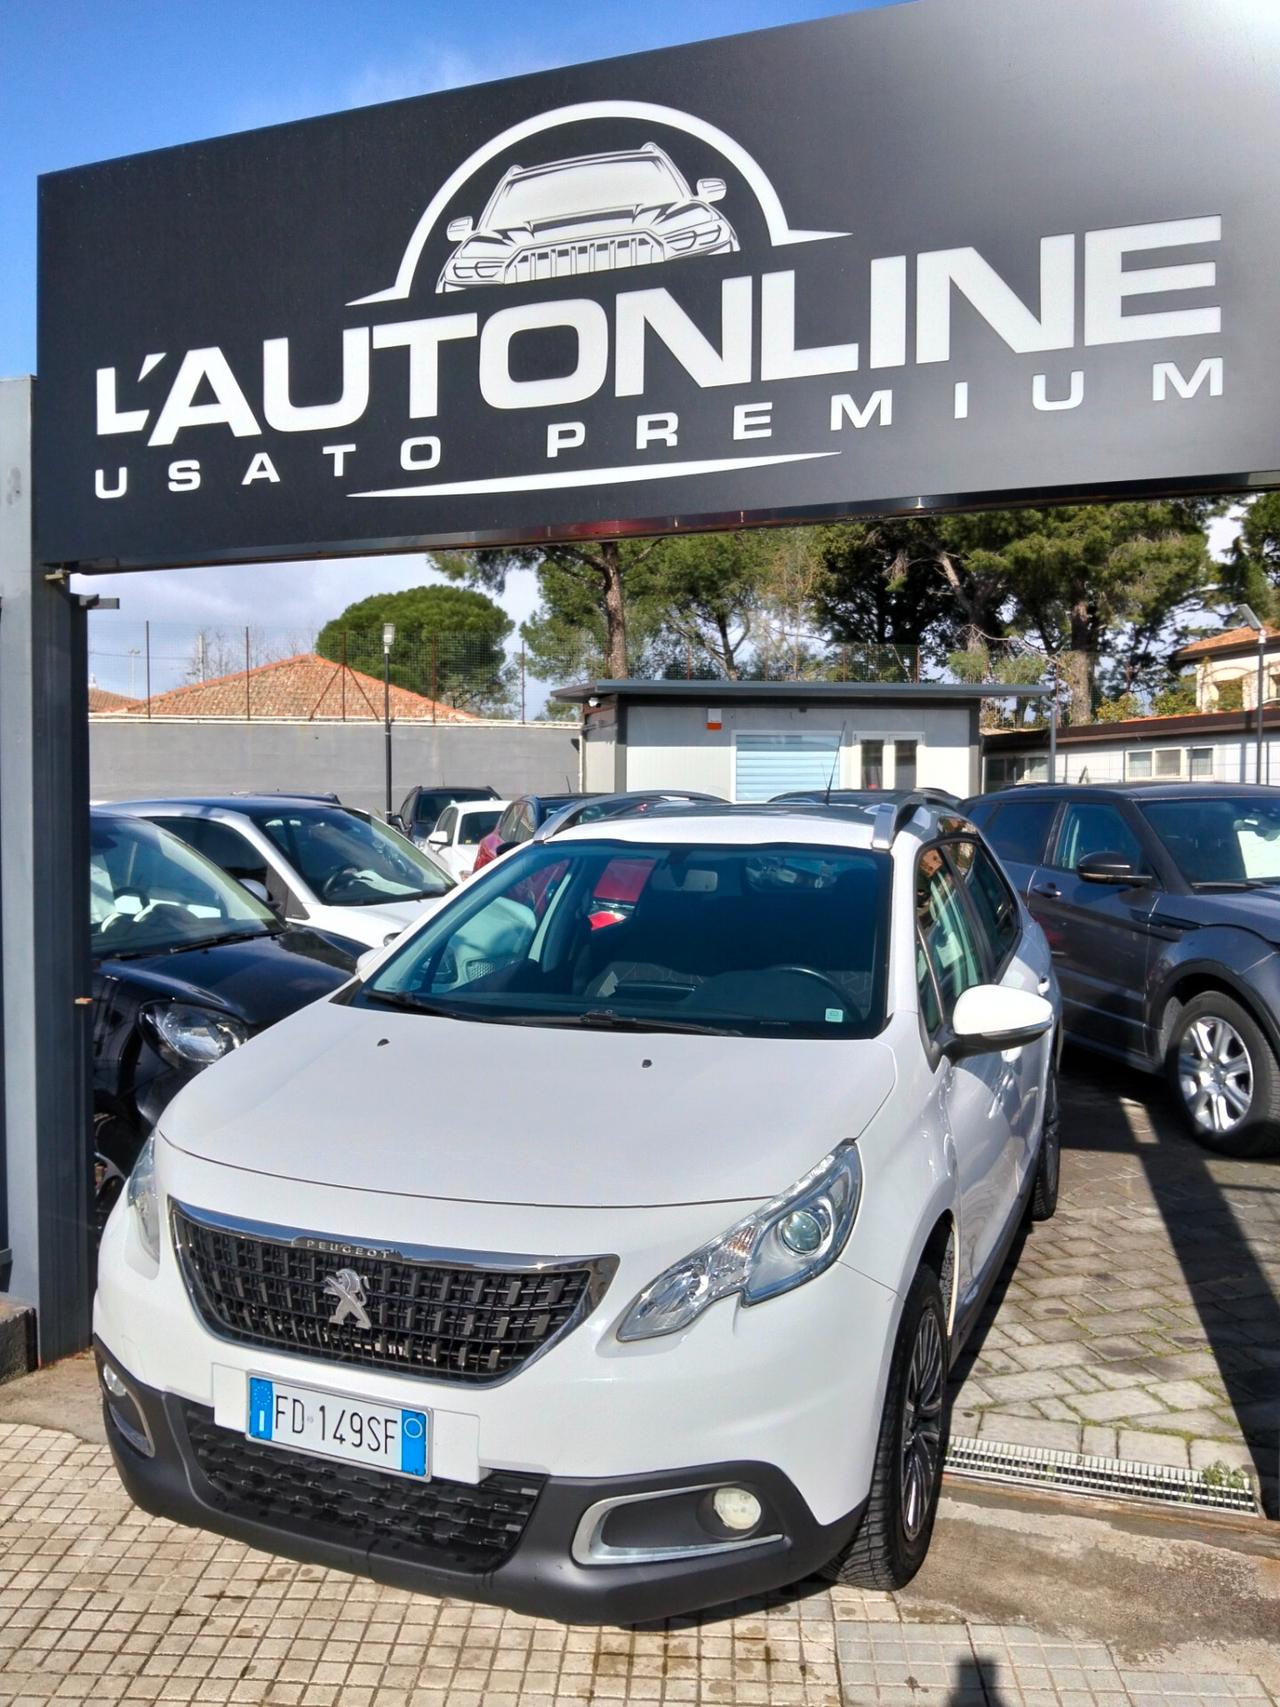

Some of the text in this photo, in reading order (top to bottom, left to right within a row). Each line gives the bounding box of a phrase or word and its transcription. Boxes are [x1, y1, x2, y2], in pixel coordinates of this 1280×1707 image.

[94, 356, 1224, 500] USATO PREMIUM
[306, 1240, 390, 1259] PEUGEOT
